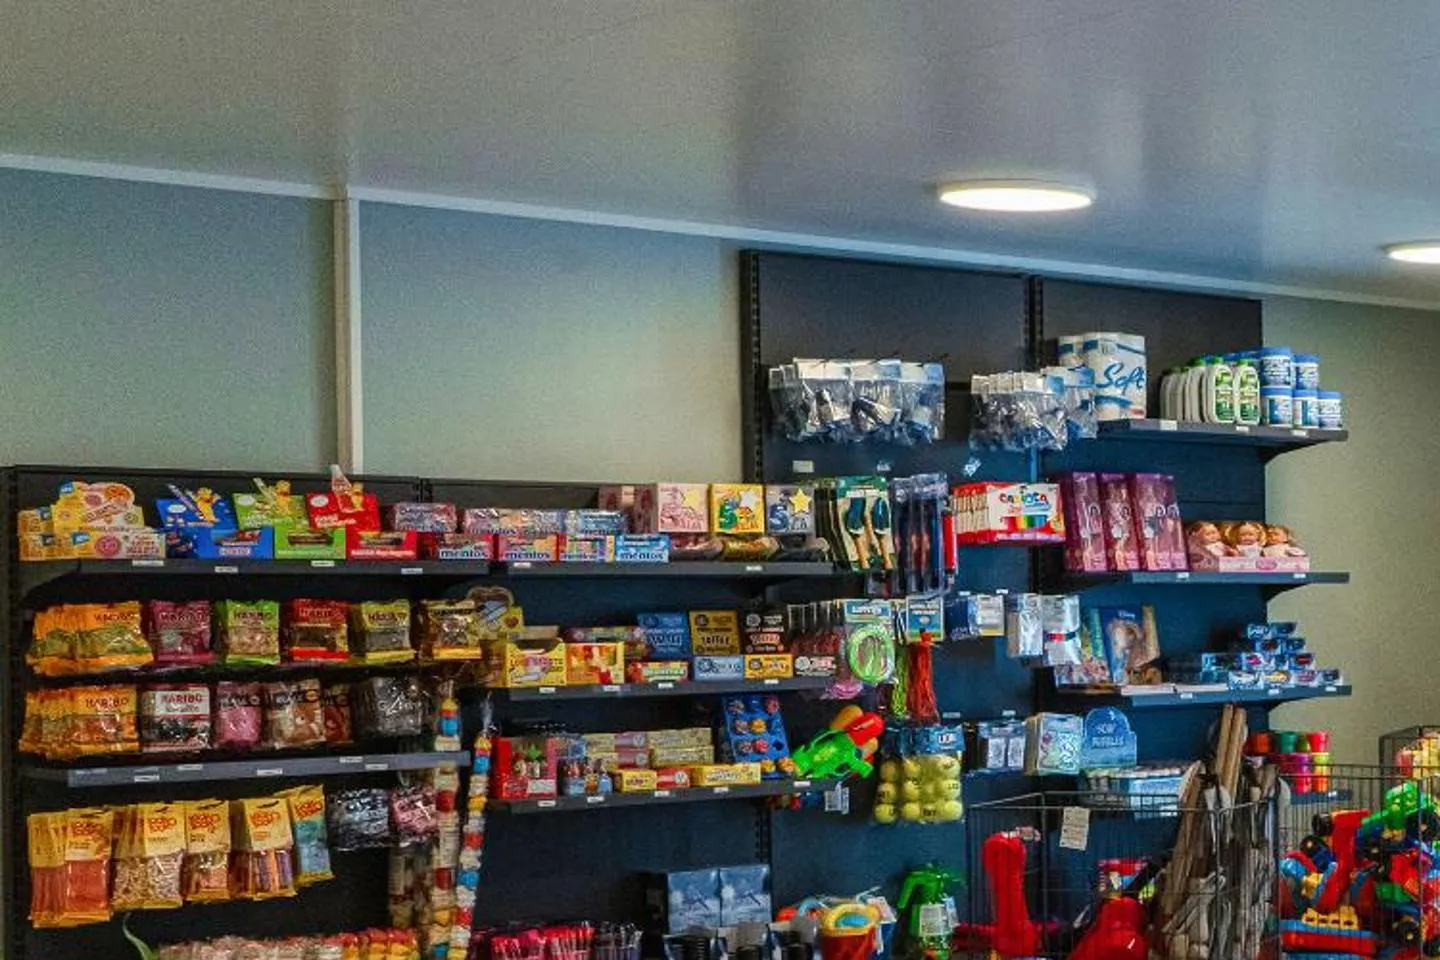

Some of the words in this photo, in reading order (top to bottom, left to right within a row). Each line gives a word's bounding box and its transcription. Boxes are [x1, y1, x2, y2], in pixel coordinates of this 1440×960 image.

[1096, 362, 1145, 396] Soft
[440, 548, 489, 559] mentos
[505, 549, 551, 560] mentos
[619, 550, 664, 561] mentos
[85, 697, 129, 709] HARIBO
[162, 694, 204, 704] HARIBO
